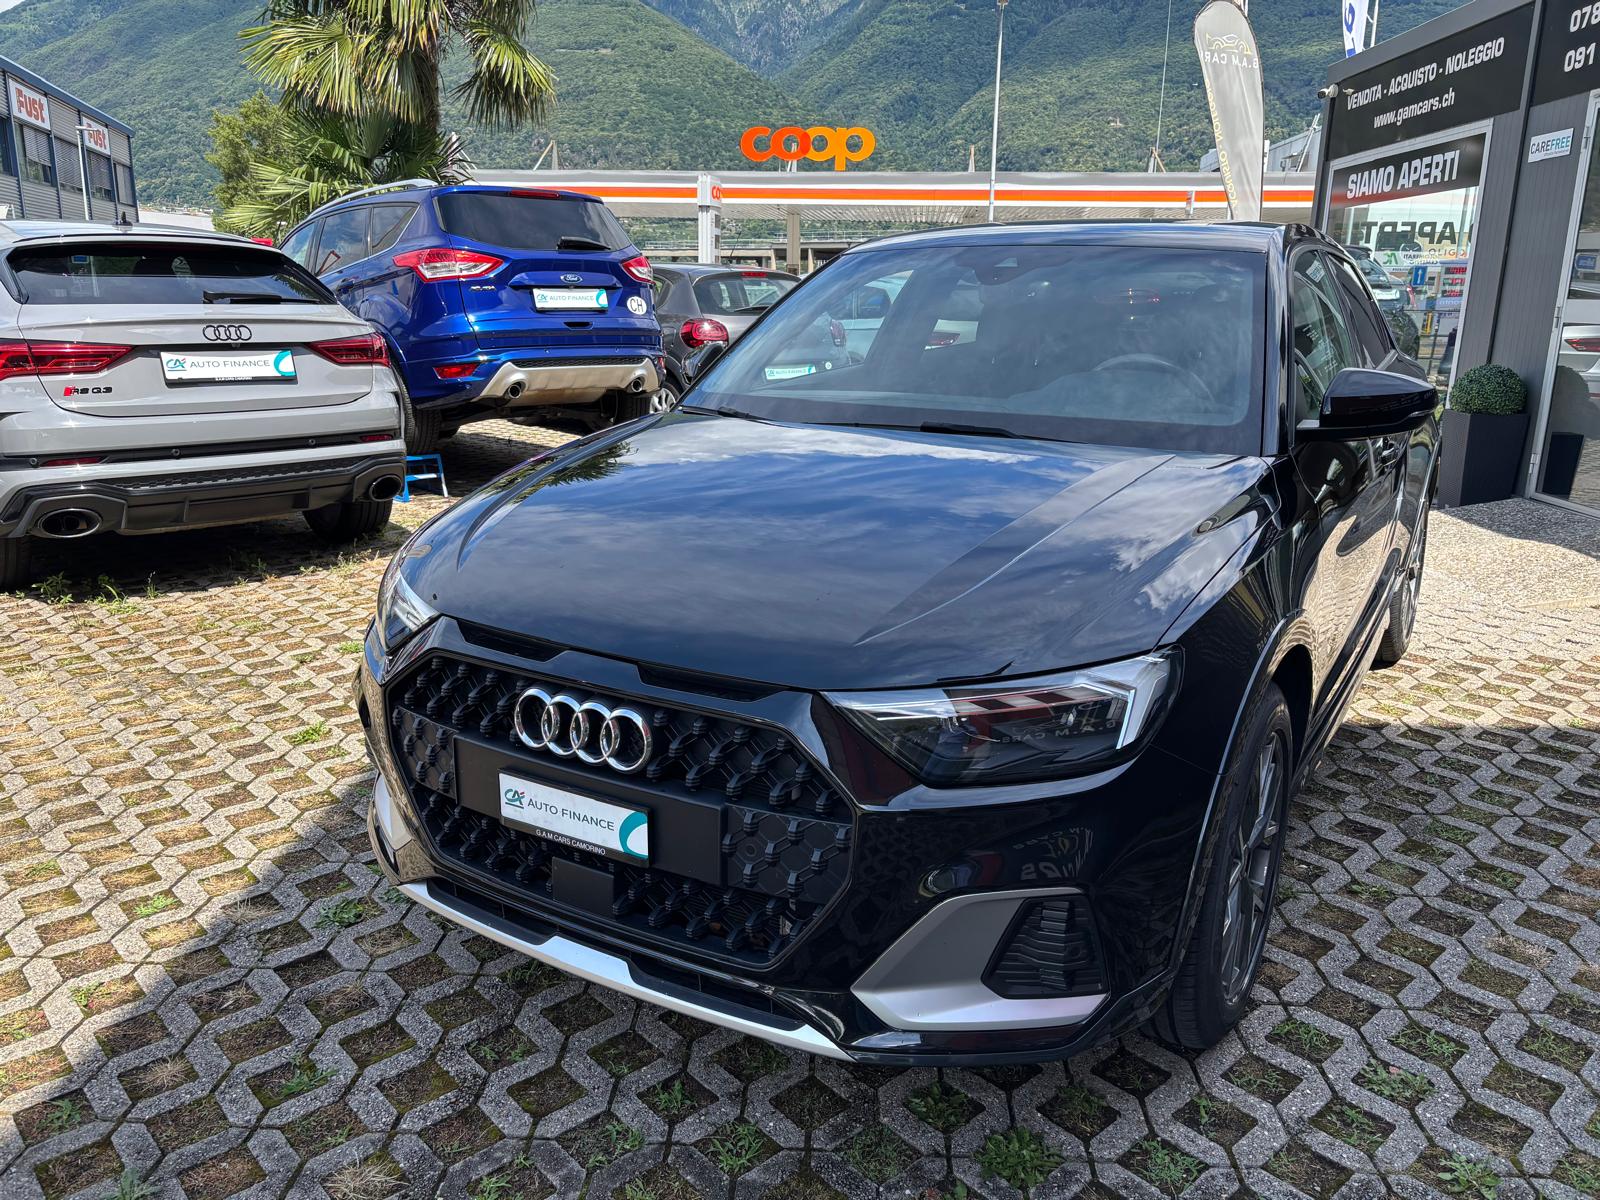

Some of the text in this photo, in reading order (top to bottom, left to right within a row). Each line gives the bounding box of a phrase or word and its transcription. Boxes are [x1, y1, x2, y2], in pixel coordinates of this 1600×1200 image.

[1570, 1, 1600, 33] 078
[1564, 42, 1596, 72] 091
[1347, 84, 1382, 110] VENDITA
[1388, 67, 1437, 97] ACQUISTO
[1445, 37, 1505, 76] NOLEGGIO
[1374, 88, 1455, 129] www.gamcars.ch
[740, 126, 876, 171] coop
[1530, 136, 1571, 155] CAREFREE
[1347, 150, 1460, 199] SIAMO APERTI
[629, 298, 644, 312] CH
[190, 360, 220, 368] AUTO
[223, 360, 270, 368] FINANCE
[92, 386, 112, 394] Q3
[527, 798, 558, 815] AUTO
[561, 808, 615, 831] FINANCE
[553, 834, 571, 845] CARS
[571, 840, 606, 855] CAMORINO
